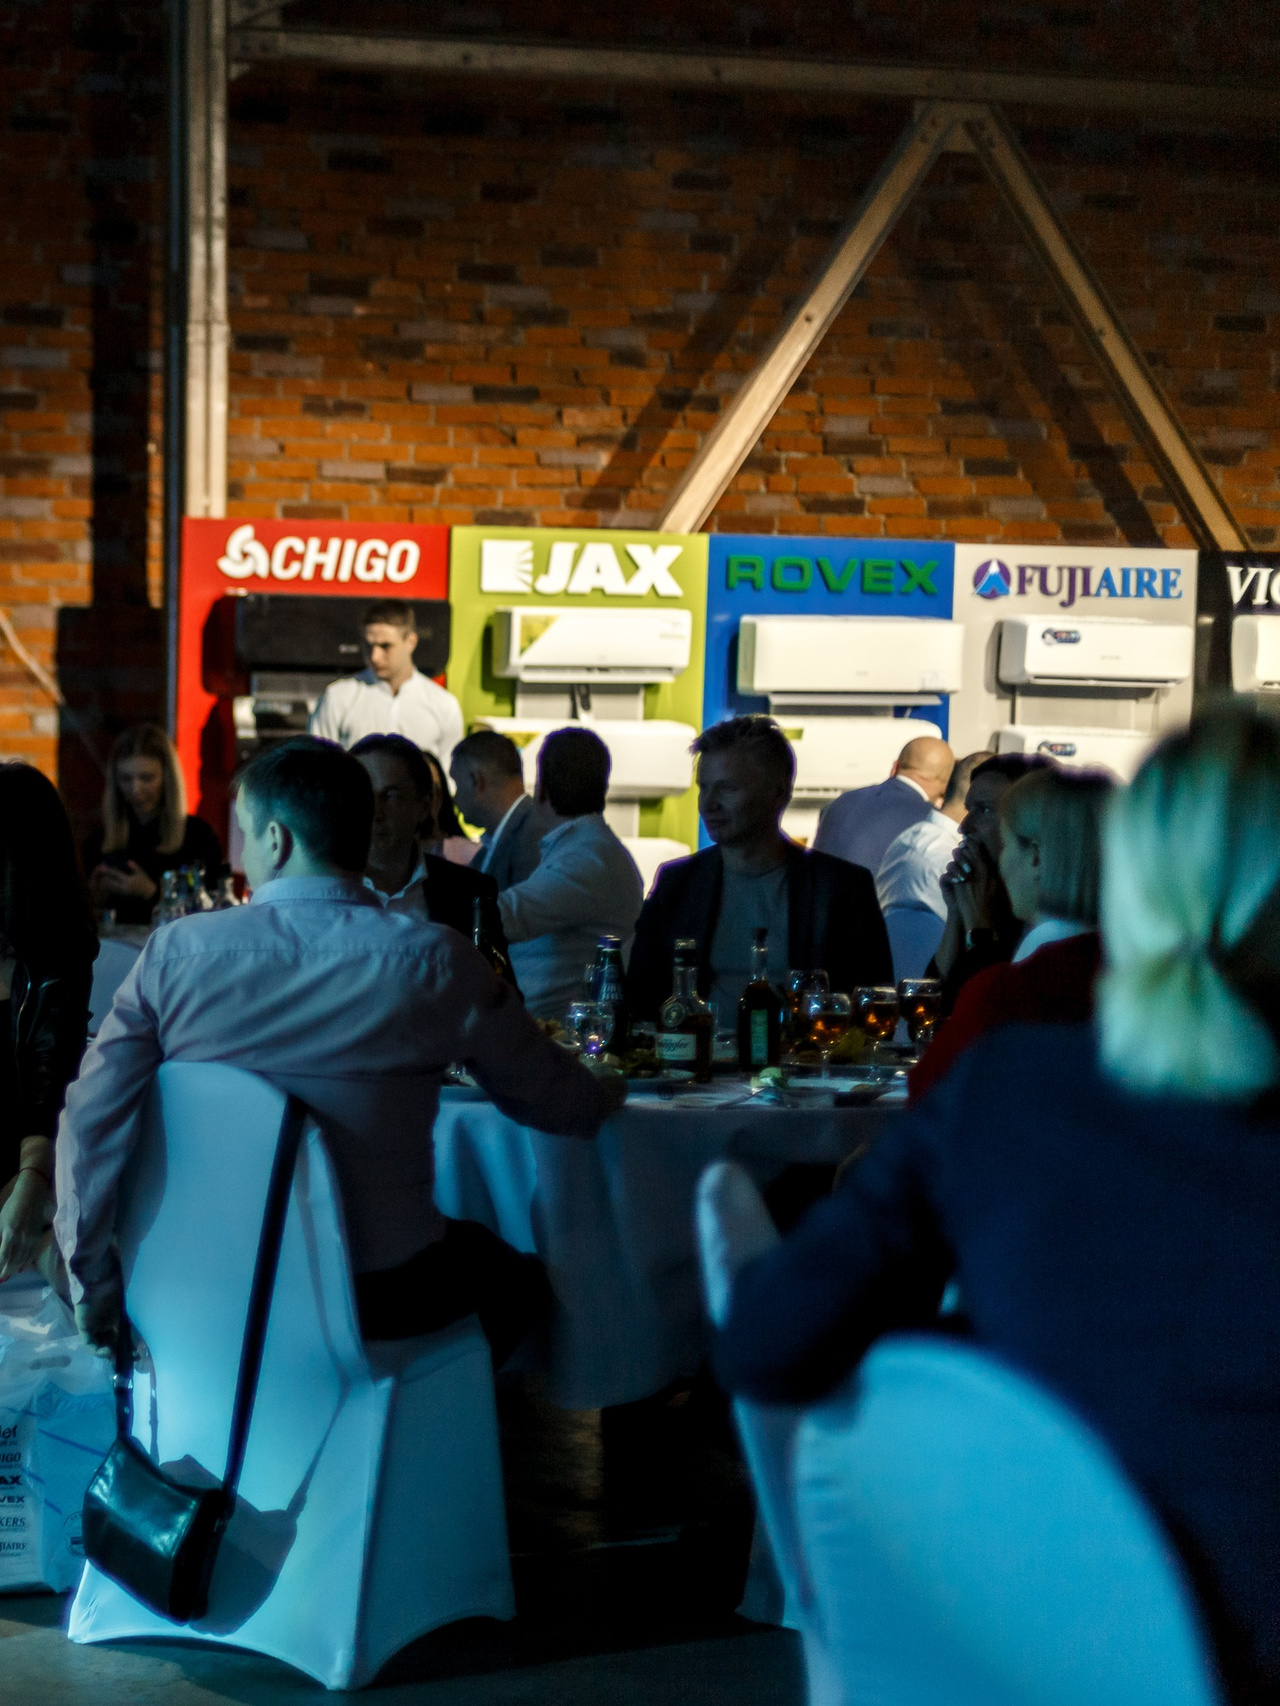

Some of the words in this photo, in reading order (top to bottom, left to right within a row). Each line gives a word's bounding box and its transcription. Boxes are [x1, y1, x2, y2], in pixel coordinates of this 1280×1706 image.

[271, 536, 421, 584] CHIGO
[534, 541, 684, 598] JAX
[727, 554, 939, 595] ROVEX
[1016, 564, 1183, 608] FUJIAIRE
